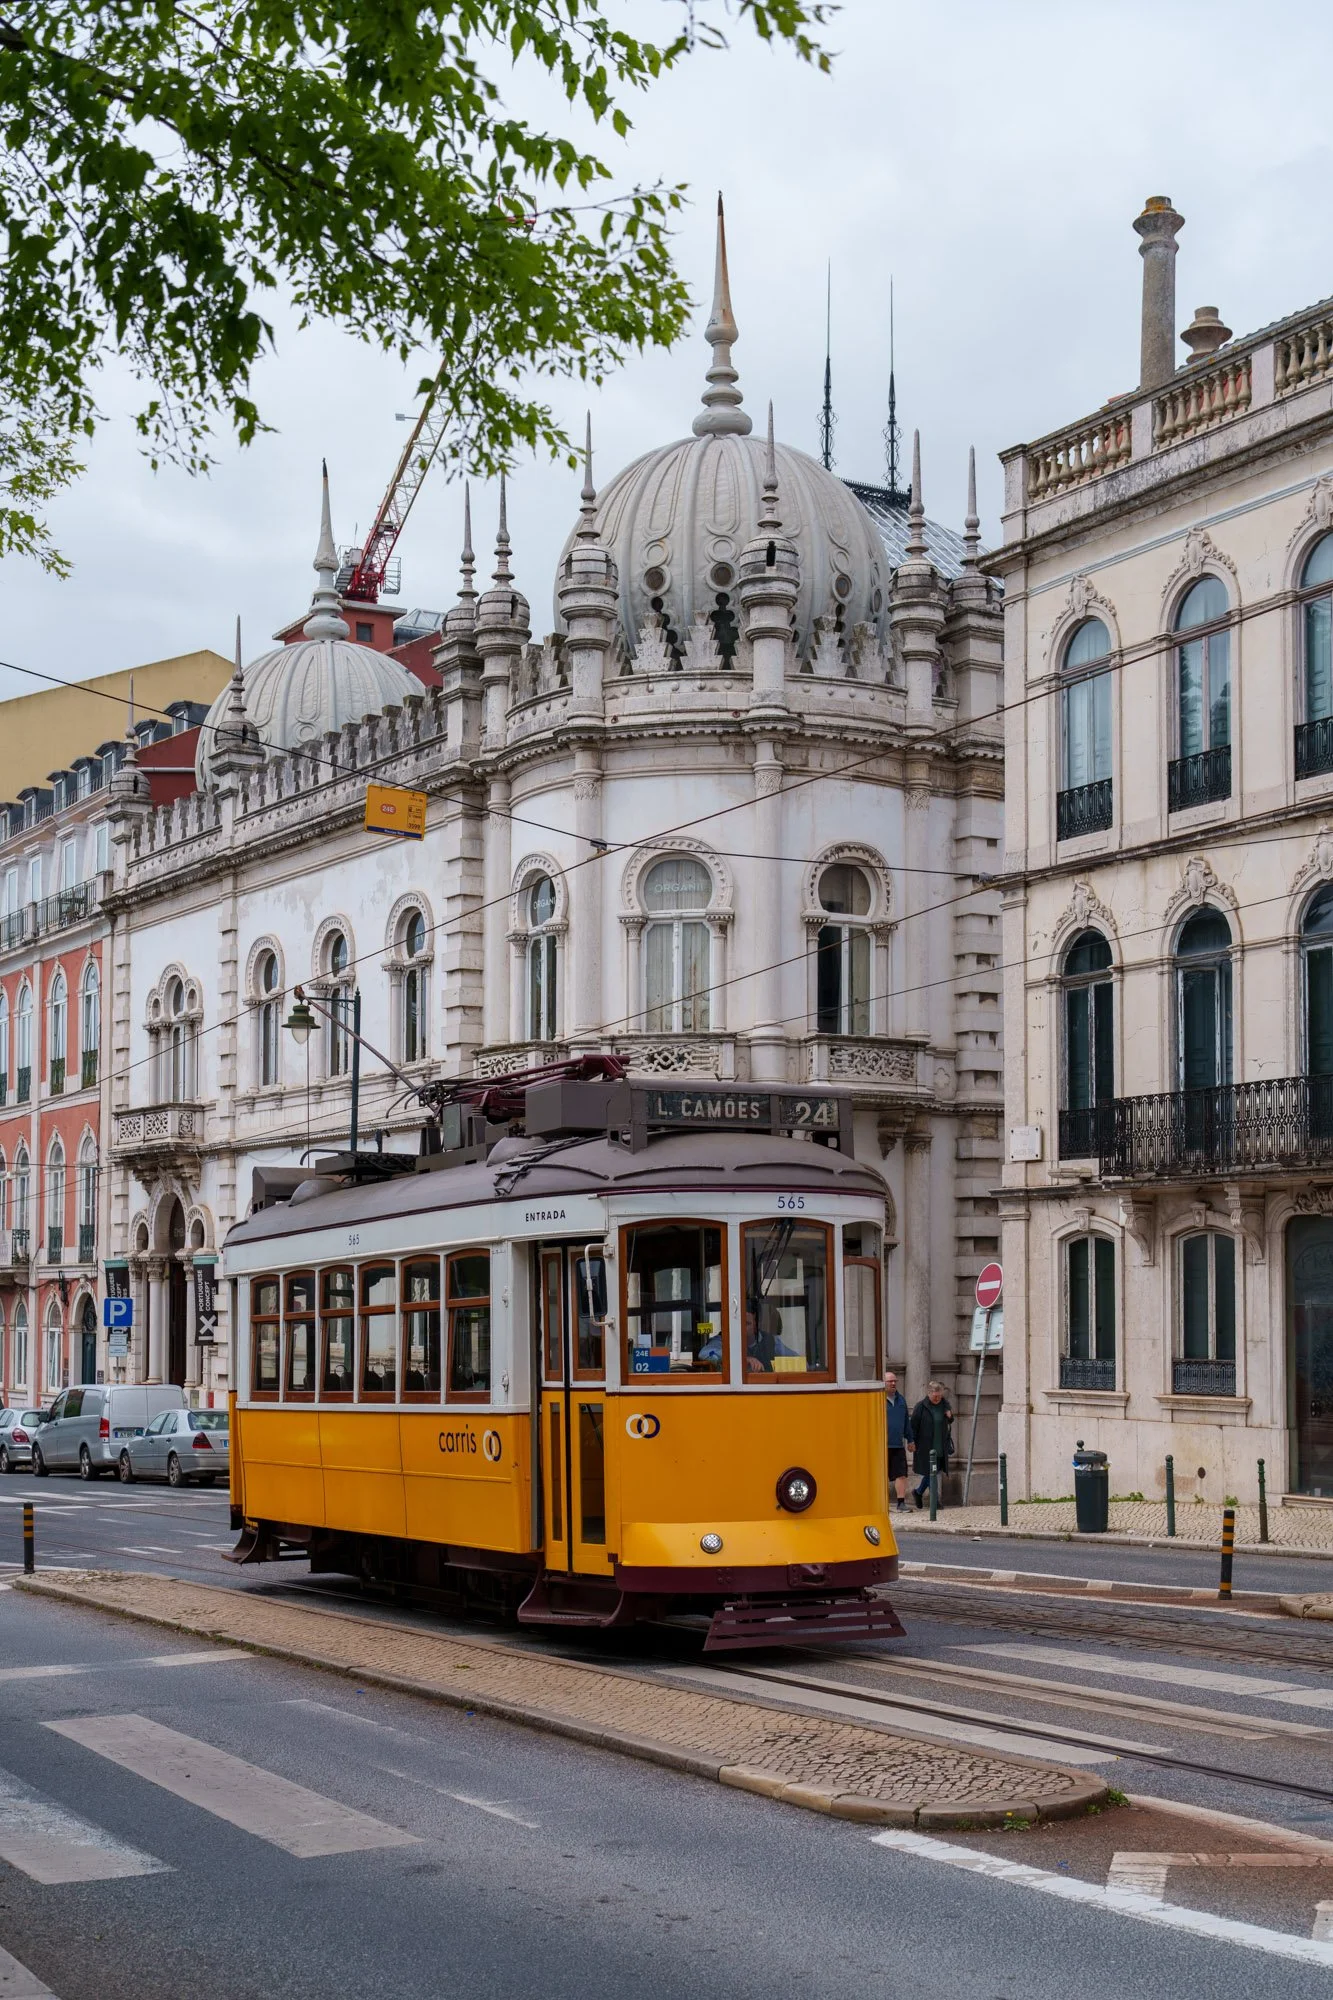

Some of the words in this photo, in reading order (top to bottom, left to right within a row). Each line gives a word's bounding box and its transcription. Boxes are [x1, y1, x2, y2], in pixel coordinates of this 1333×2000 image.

[657, 1097, 673, 1116] L.
[681, 1098, 760, 1119] CAMÕES
[795, 1101, 831, 1127] 24
[777, 1195, 805, 1209] 565
[525, 1209, 566, 1222] ENTRADA
[348, 1233, 360, 1246] 565
[109, 1300, 127, 1325] P
[635, 1362, 649, 1372] 02
[438, 1423, 477, 1454] carris
